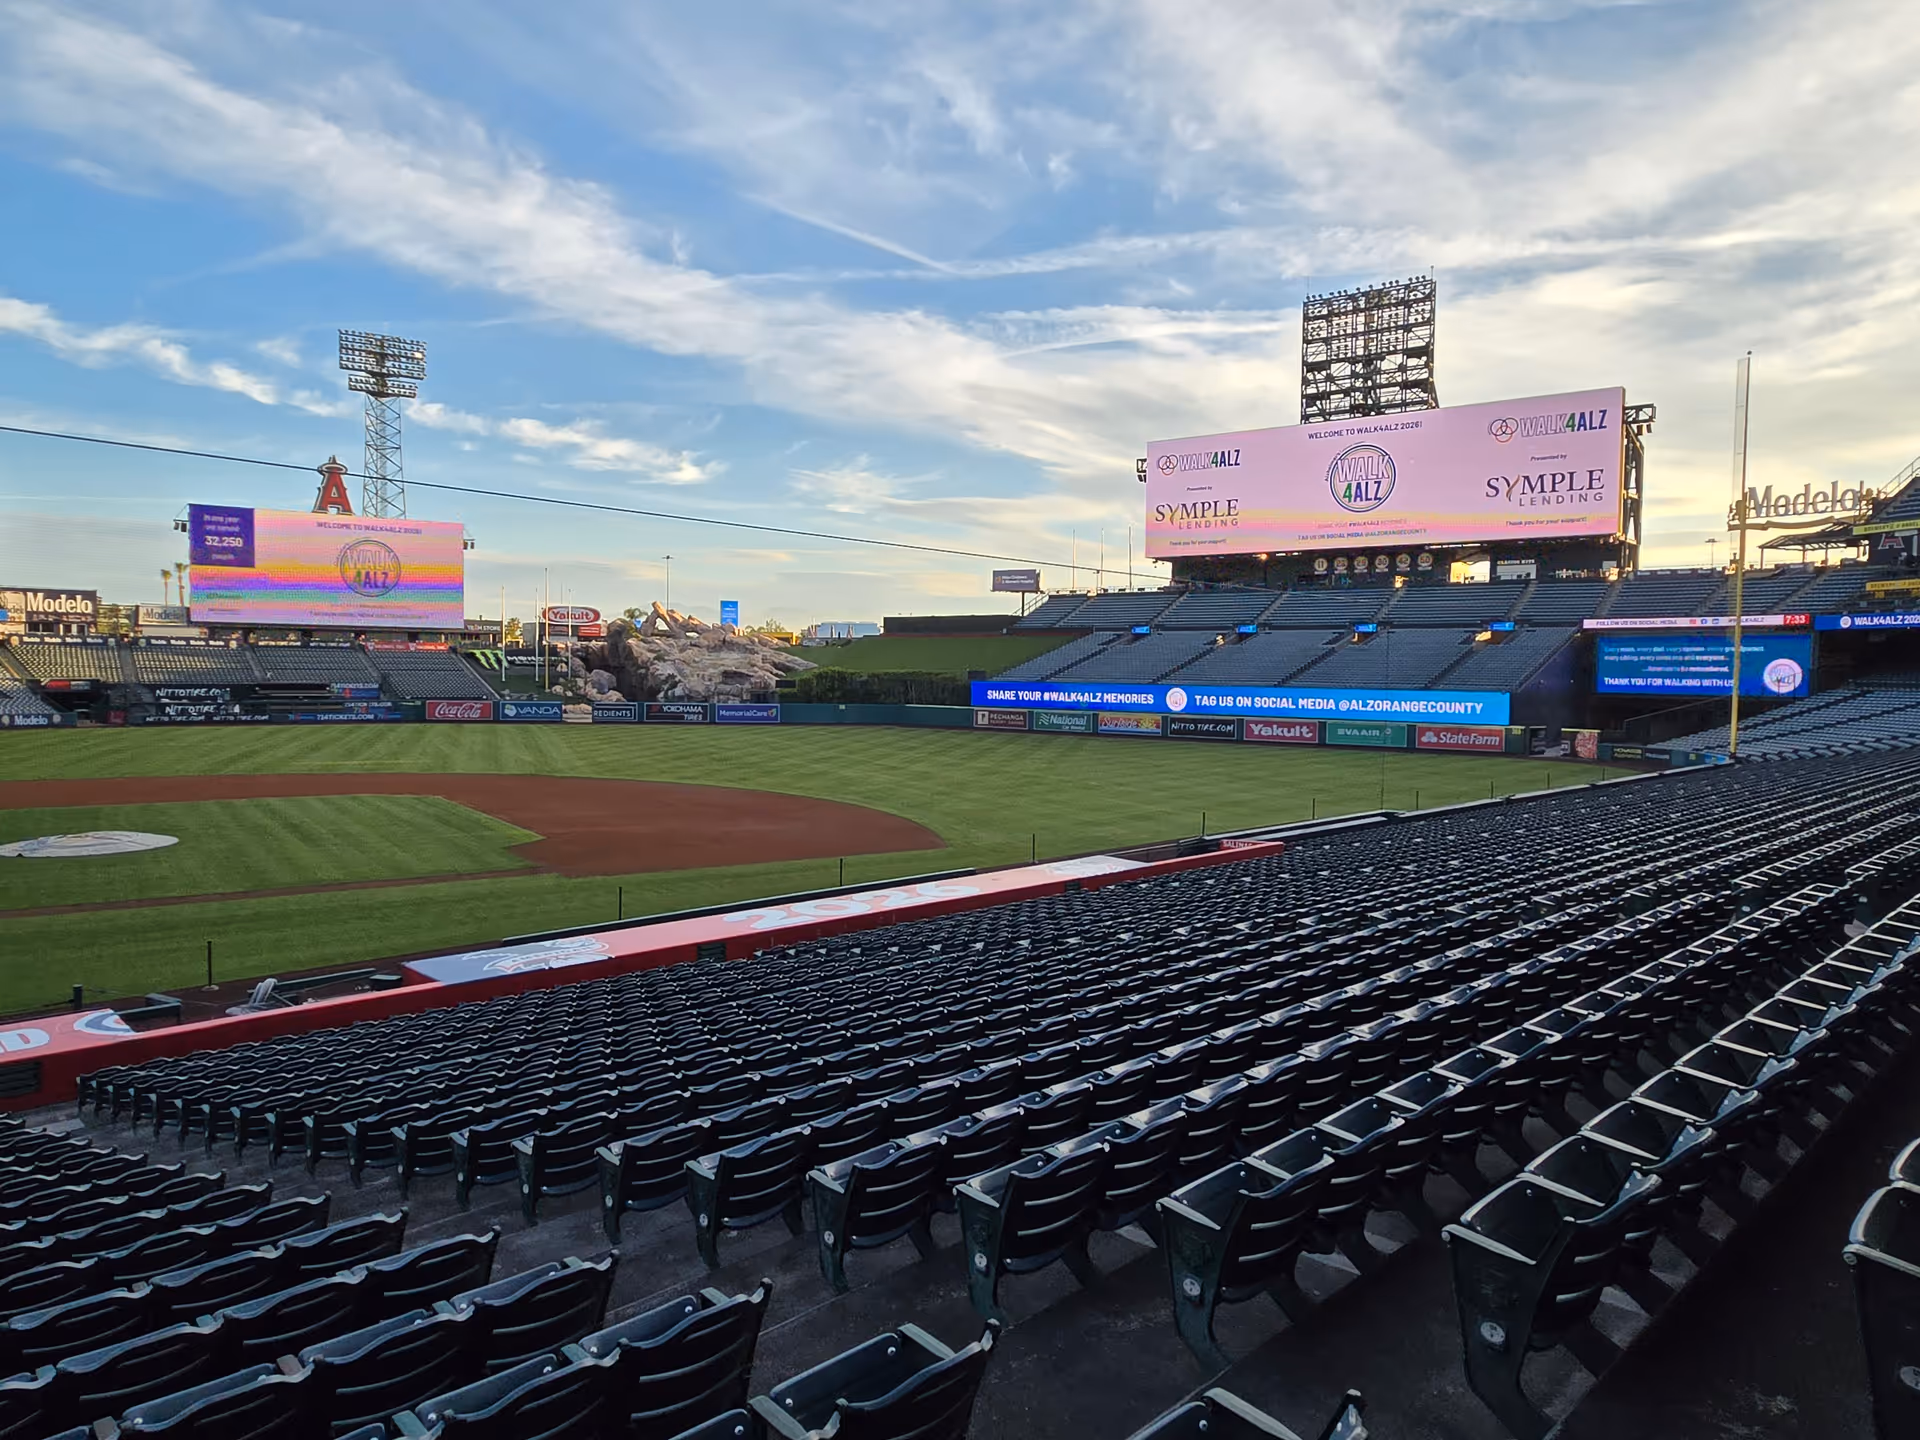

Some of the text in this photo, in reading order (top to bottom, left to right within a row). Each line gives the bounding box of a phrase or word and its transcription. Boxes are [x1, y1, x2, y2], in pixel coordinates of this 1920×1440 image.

[1308, 430, 1344, 439] WELCOME
[1357, 423, 1399, 434] WALK4ALZ
[1400, 421, 1422, 430] 2026!
[1520, 409, 1607, 438] WALK4ALZ
[1178, 449, 1241, 472] WALK4ALZ
[1337, 454, 1390, 483] WALK
[1343, 480, 1383, 503] 4ALZ
[1486, 468, 1605, 502] SYMPLE
[1519, 492, 1603, 506] LENDING
[1748, 481, 1858, 517] Modelo
[1155, 498, 1239, 526] SYMPLE
[316, 522, 352, 530] WELCOME
[1178, 518, 1239, 530] LENDING
[204, 536, 243, 548] 32,250
[344, 549, 399, 572] WALK
[353, 570, 389, 590] 4ALZ
[26, 592, 92, 614] Modelo
[1786, 616, 1806, 624] 7:33
[1854, 616, 1903, 626] WALK4ALZ
[1604, 678, 1630, 686] THANK
[987, 690, 1483, 714] SHARE YOUR #WALK4ALZ MEMORIES TAG US ON SOCIAL MEDIA @ALZORANGECOUNTY
[517, 706, 560, 714] VANDA
[720, 709, 768, 718] MemorialCare
[14, 715, 48, 725] Modelo
[990, 713, 1024, 722] PECHANGA
[1050, 714, 1087, 725] National
[1102, 716, 1138, 729] Surfside
[1171, 722, 1234, 733] NITTO TIRE.COM
[1250, 724, 1313, 738] Yakult
[722, 882, 980, 928] 2026
[0, 1028, 50, 1053] D
